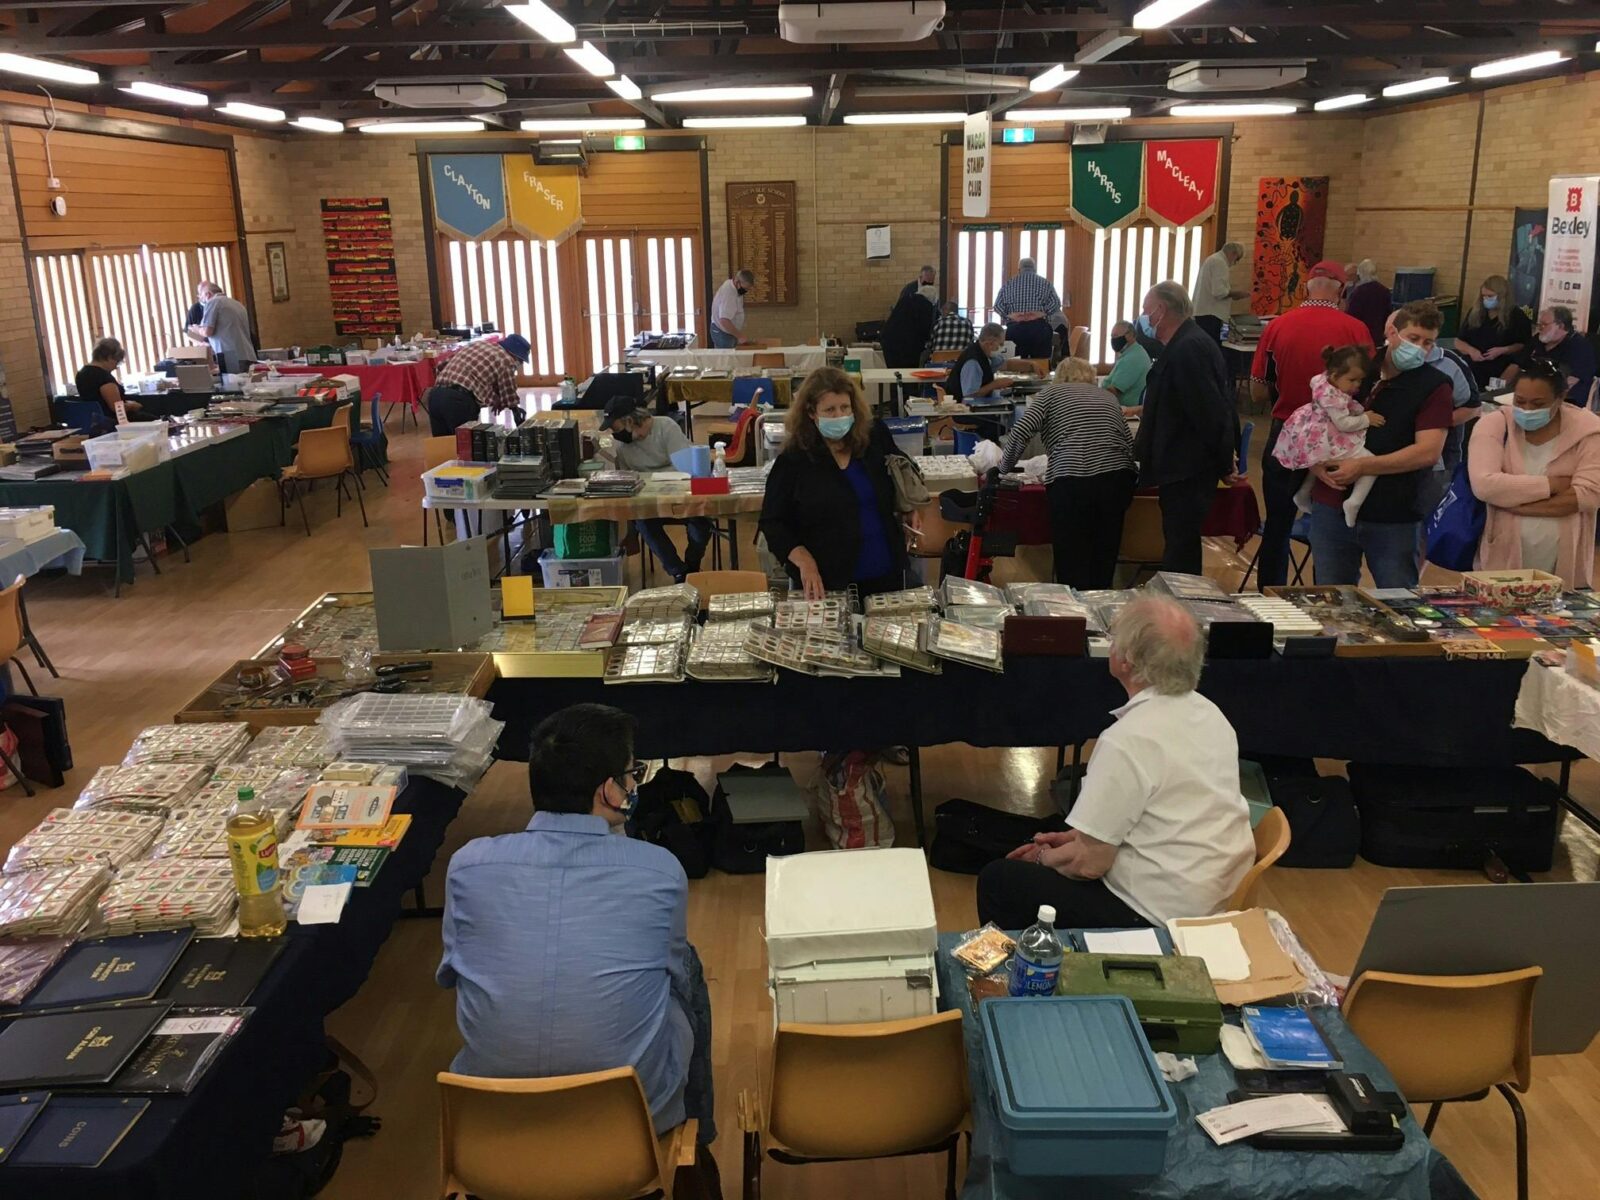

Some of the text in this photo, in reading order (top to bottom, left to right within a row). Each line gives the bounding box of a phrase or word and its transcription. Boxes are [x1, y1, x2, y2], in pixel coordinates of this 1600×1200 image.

[966, 131, 986, 151] WAGGA
[966, 156, 985, 174] STAMP
[1157, 150, 1204, 200] MACLEAY
[443, 165, 491, 210] CLAYTON
[523, 170, 564, 211] FRASER
[967, 180, 982, 197] CLUB
[1087, 160, 1122, 204] HARRIS
[1570, 193, 1577, 207] B
[1552, 216, 1591, 238] Bexley
